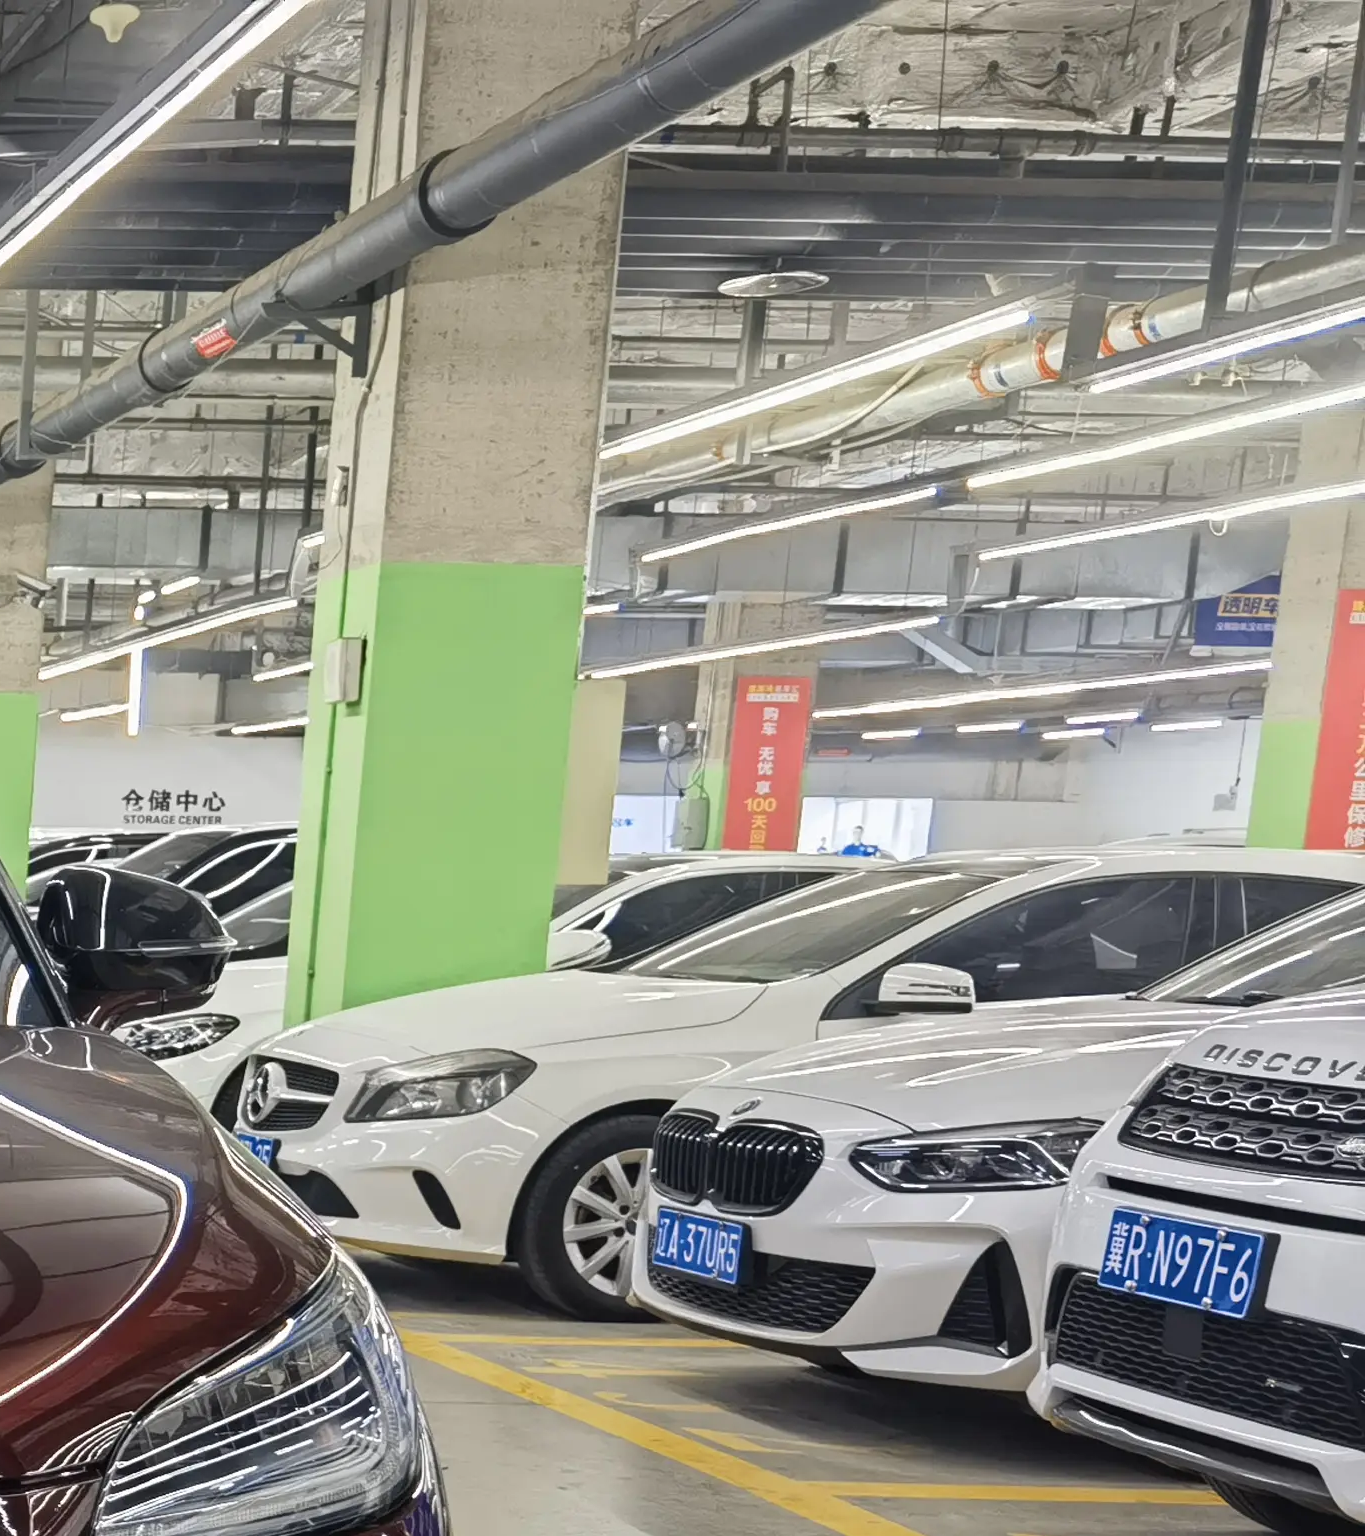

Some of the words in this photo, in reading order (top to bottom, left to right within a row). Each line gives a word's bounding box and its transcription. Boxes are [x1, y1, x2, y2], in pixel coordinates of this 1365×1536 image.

[121, 789, 226, 812] 仓储中心
[123, 814, 176, 825] STORAGE
[178, 815, 222, 825] CENTER
